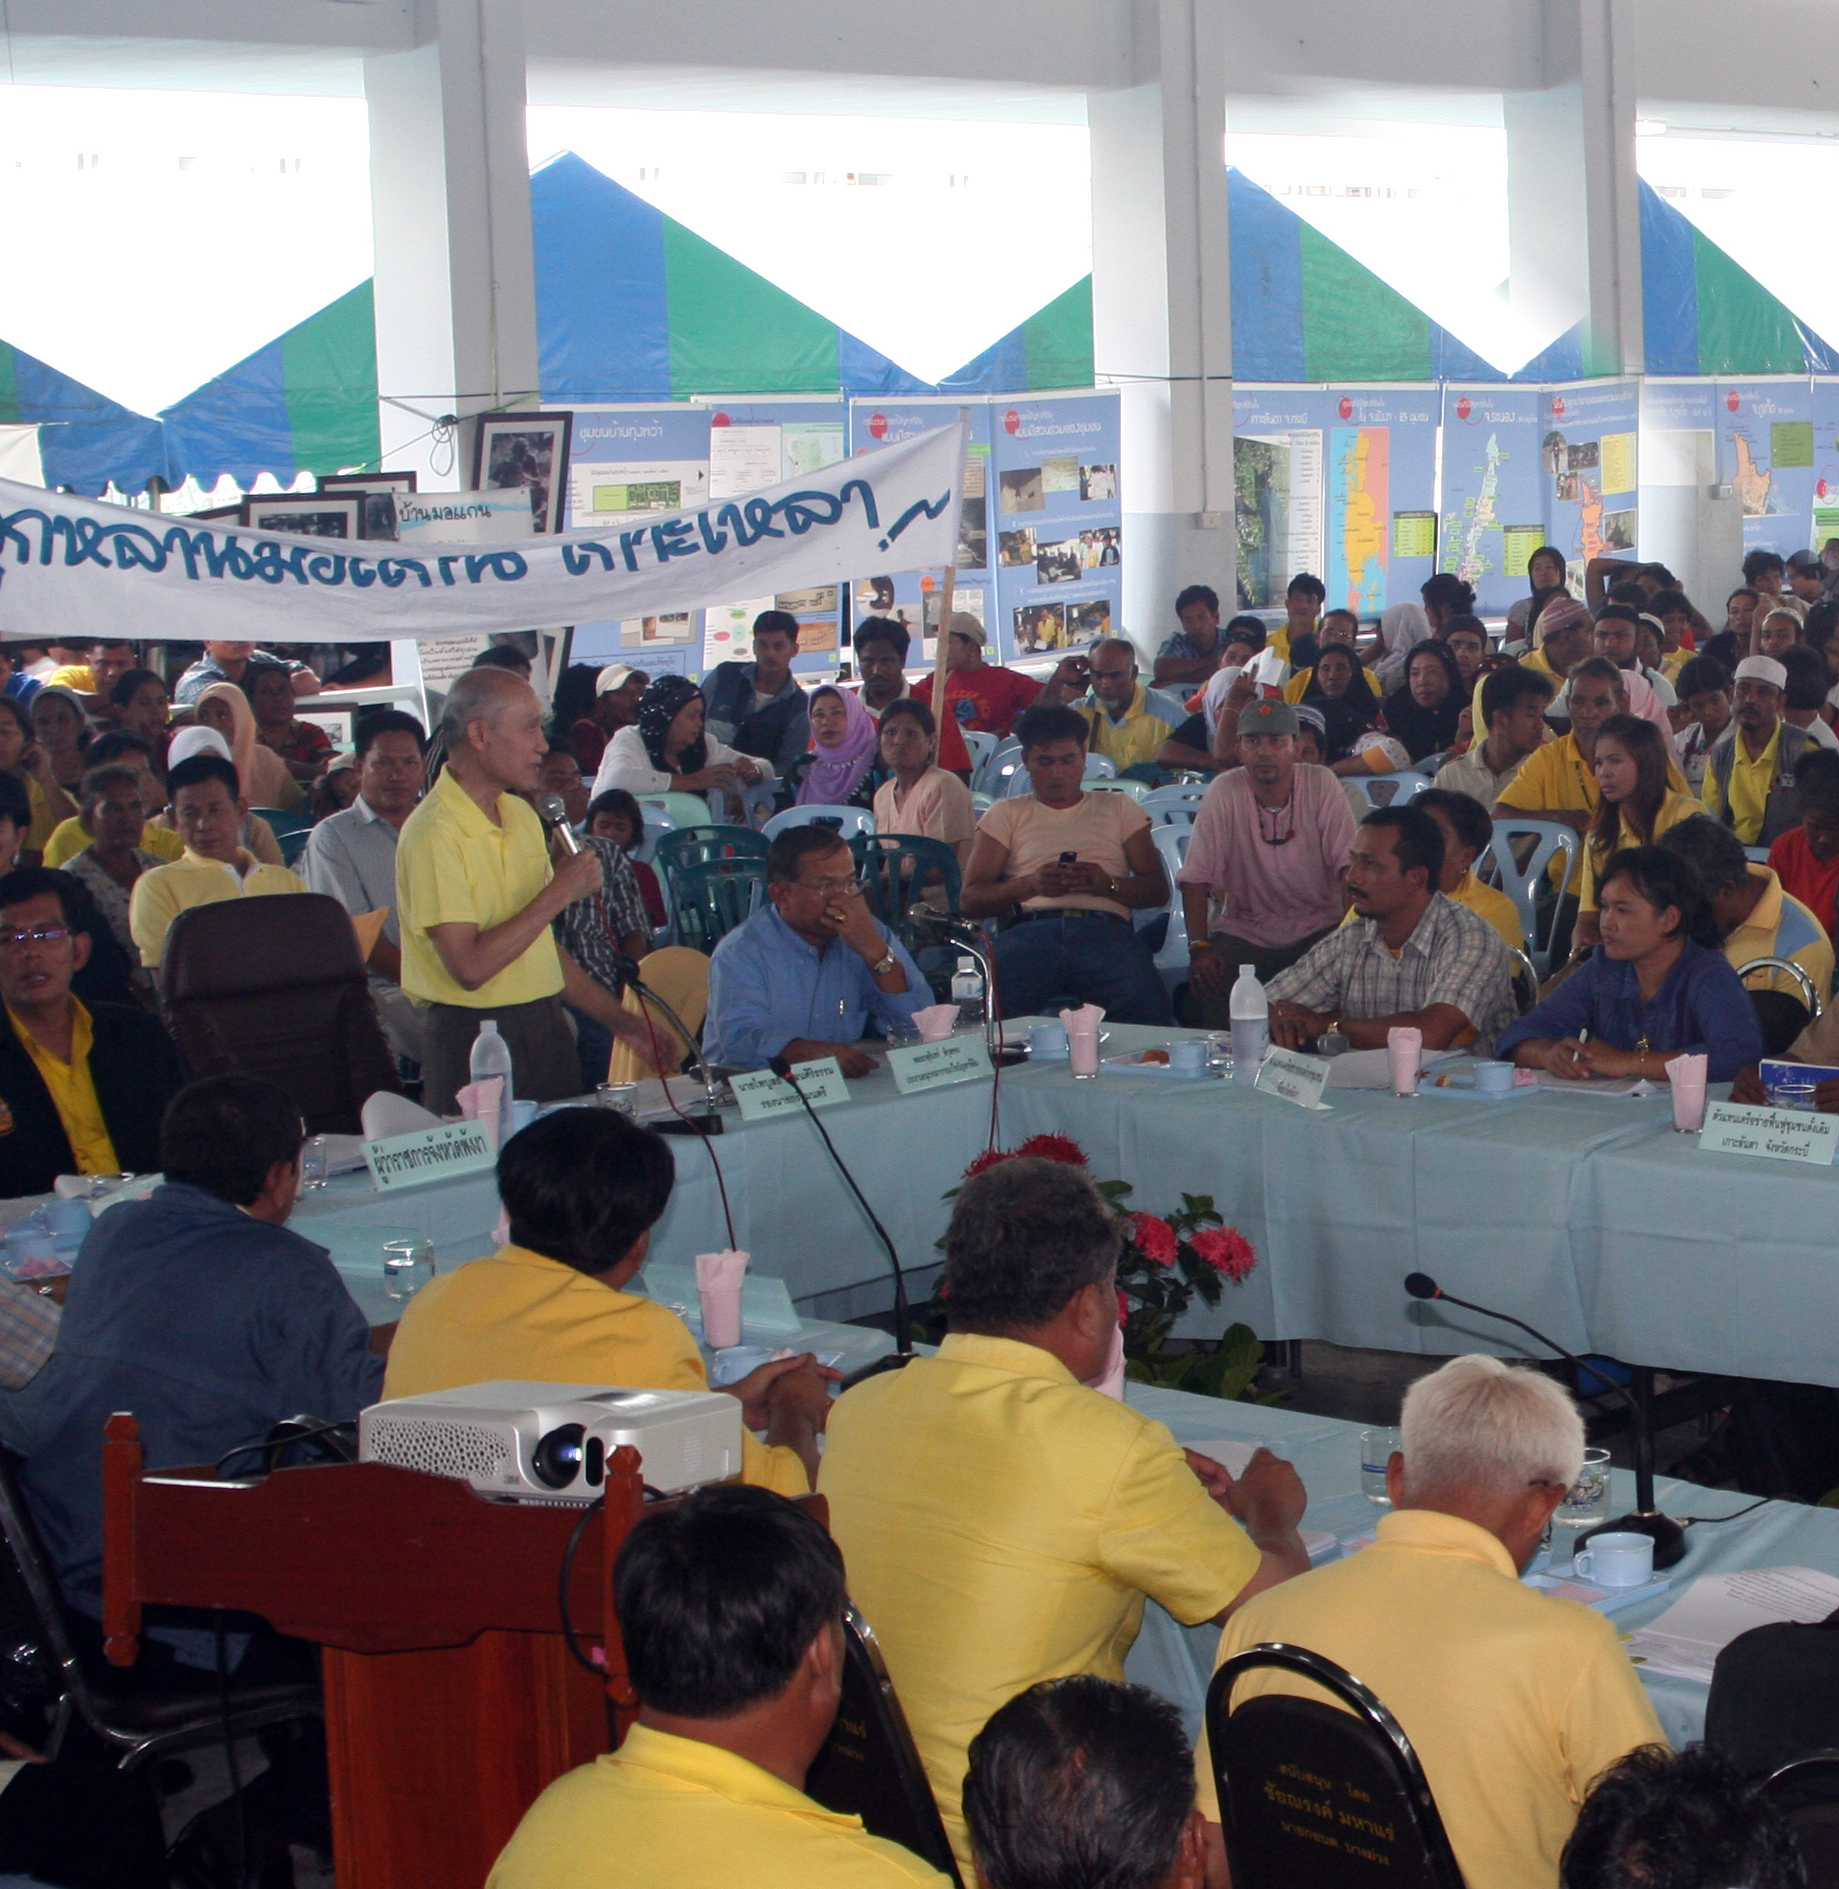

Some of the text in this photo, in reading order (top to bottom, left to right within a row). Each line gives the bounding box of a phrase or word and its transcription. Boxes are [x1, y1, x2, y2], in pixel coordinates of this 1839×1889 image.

[399, 500, 492, 523] บ้านมอแกน
[738, 1075, 785, 1092] นายไพบูลย
[372, 1128, 488, 1185] ผู้ว่าราชการจังหวัดพังงา
